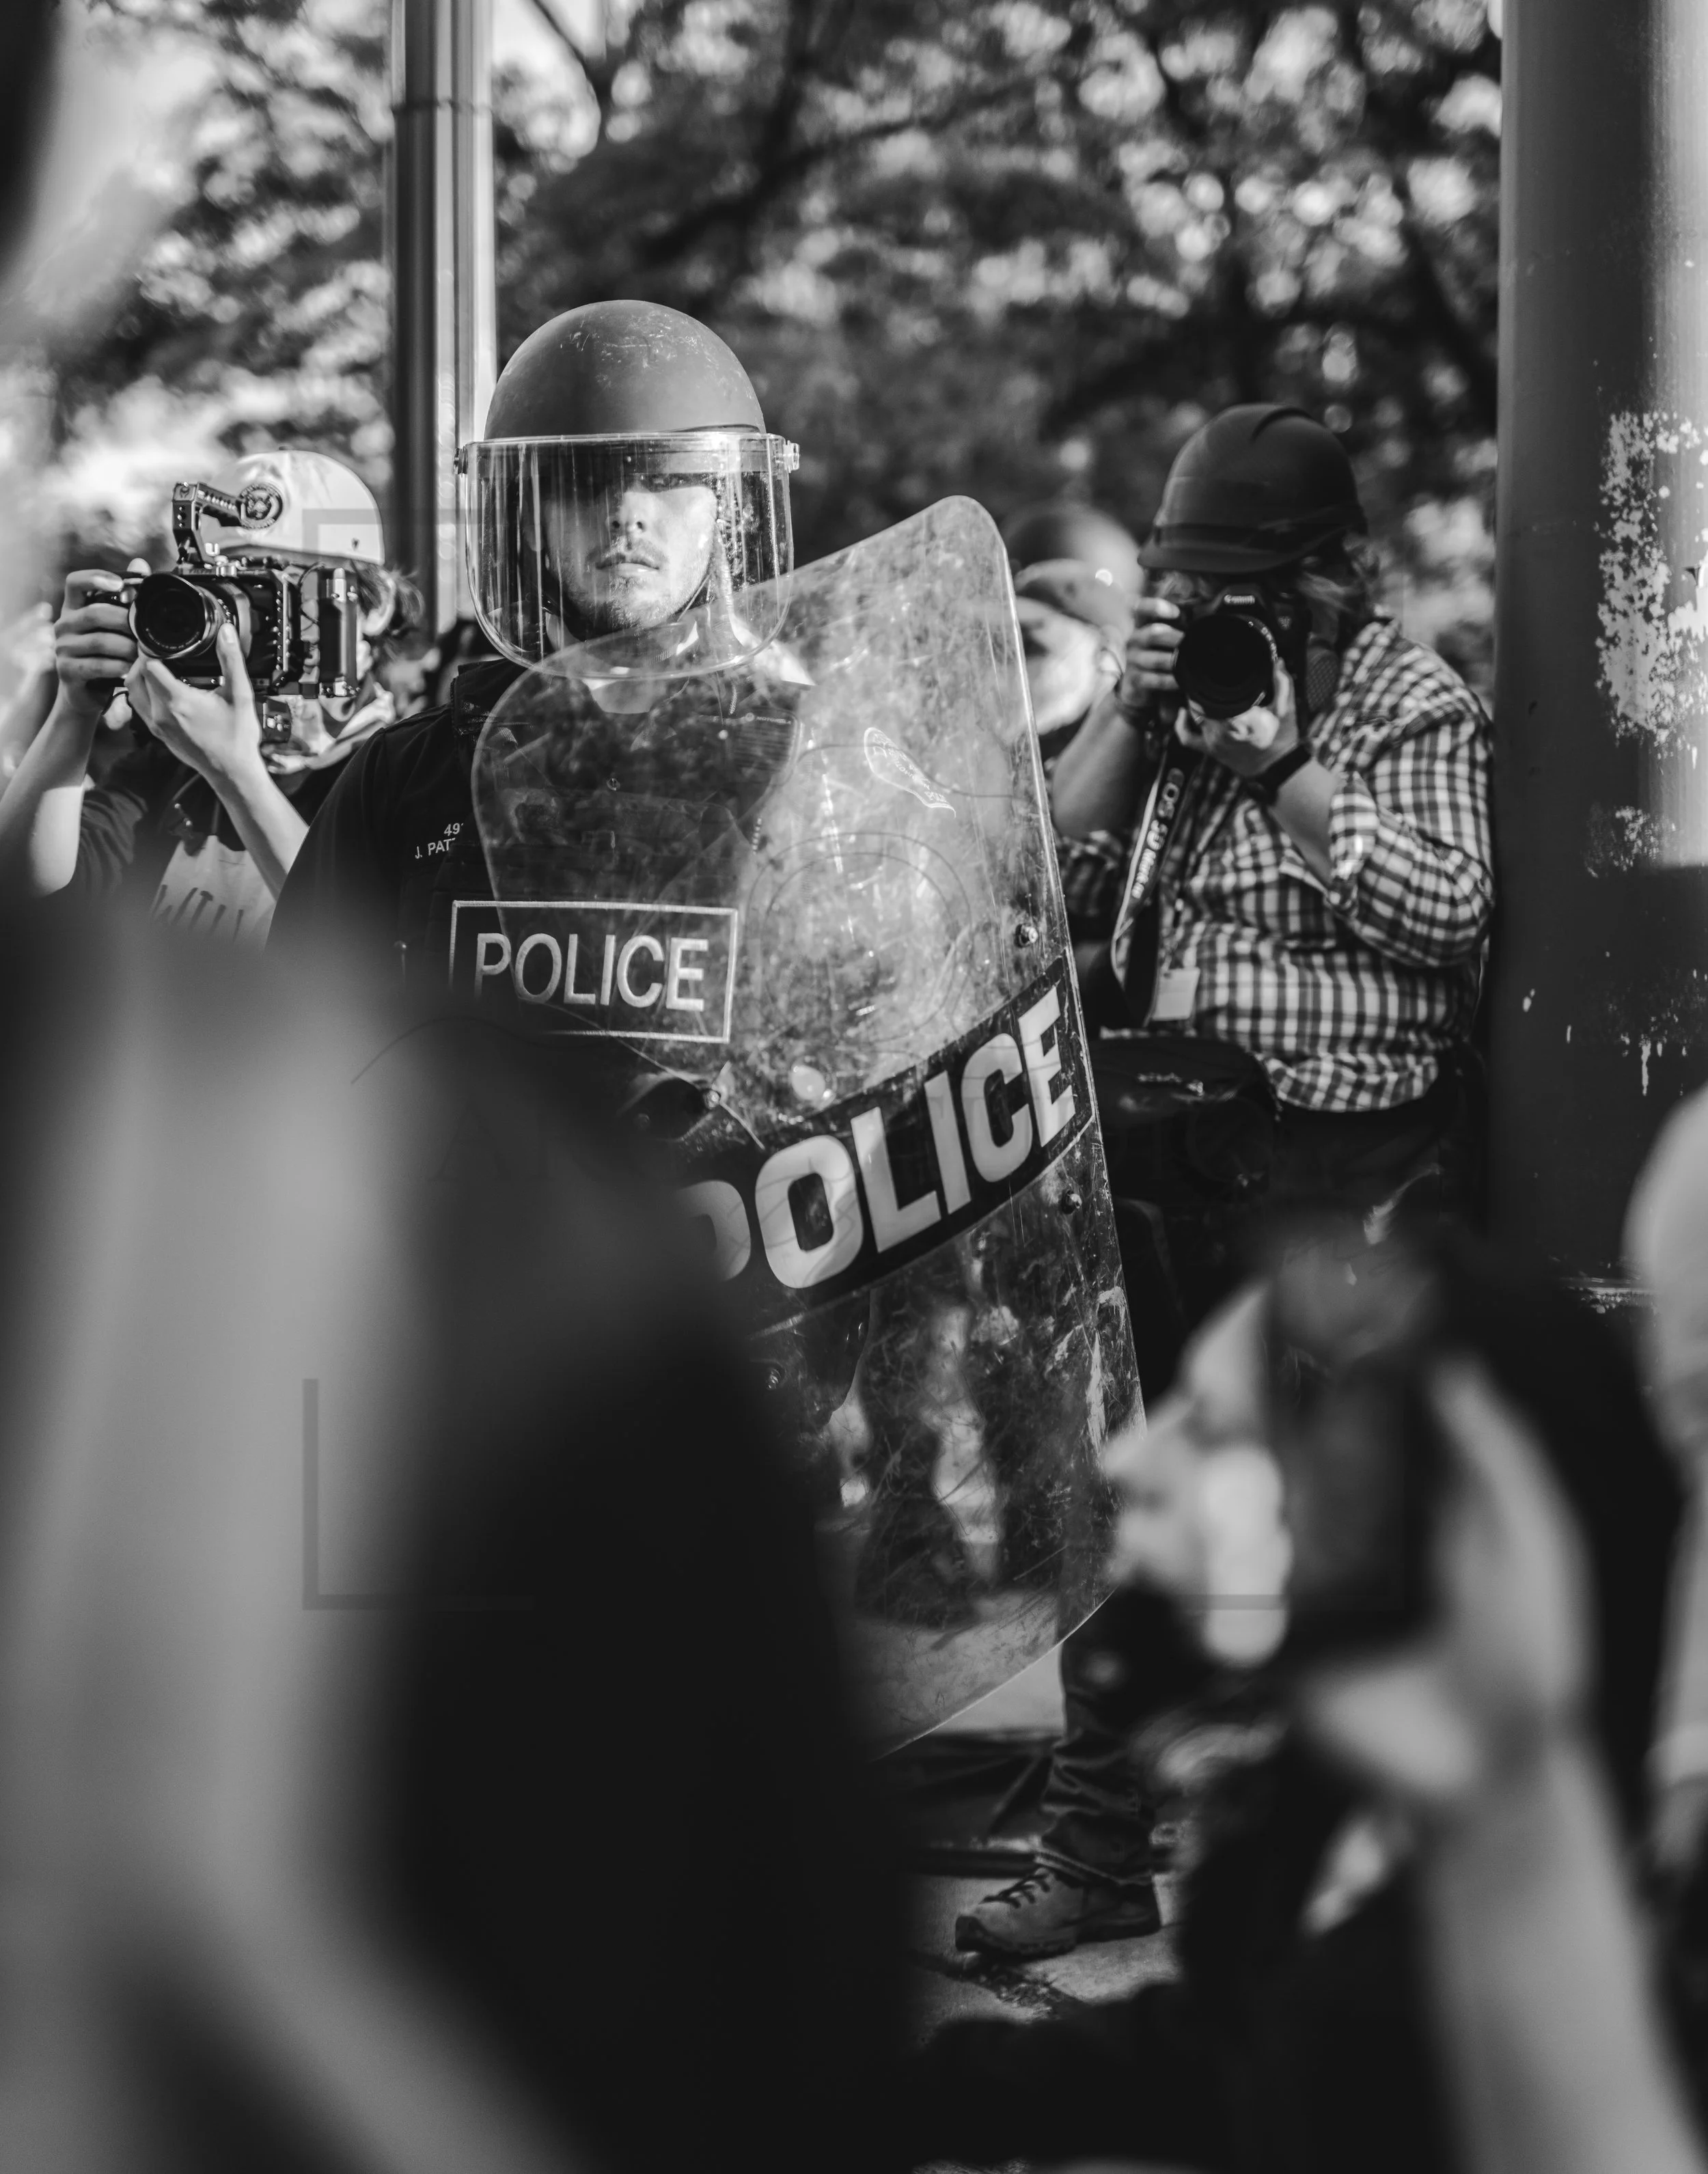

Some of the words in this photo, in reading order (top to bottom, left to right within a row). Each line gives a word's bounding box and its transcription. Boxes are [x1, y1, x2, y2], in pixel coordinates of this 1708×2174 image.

[443, 823, 464, 836] 49
[428, 838, 456, 856] PAT
[475, 932, 709, 1012] POLICE
